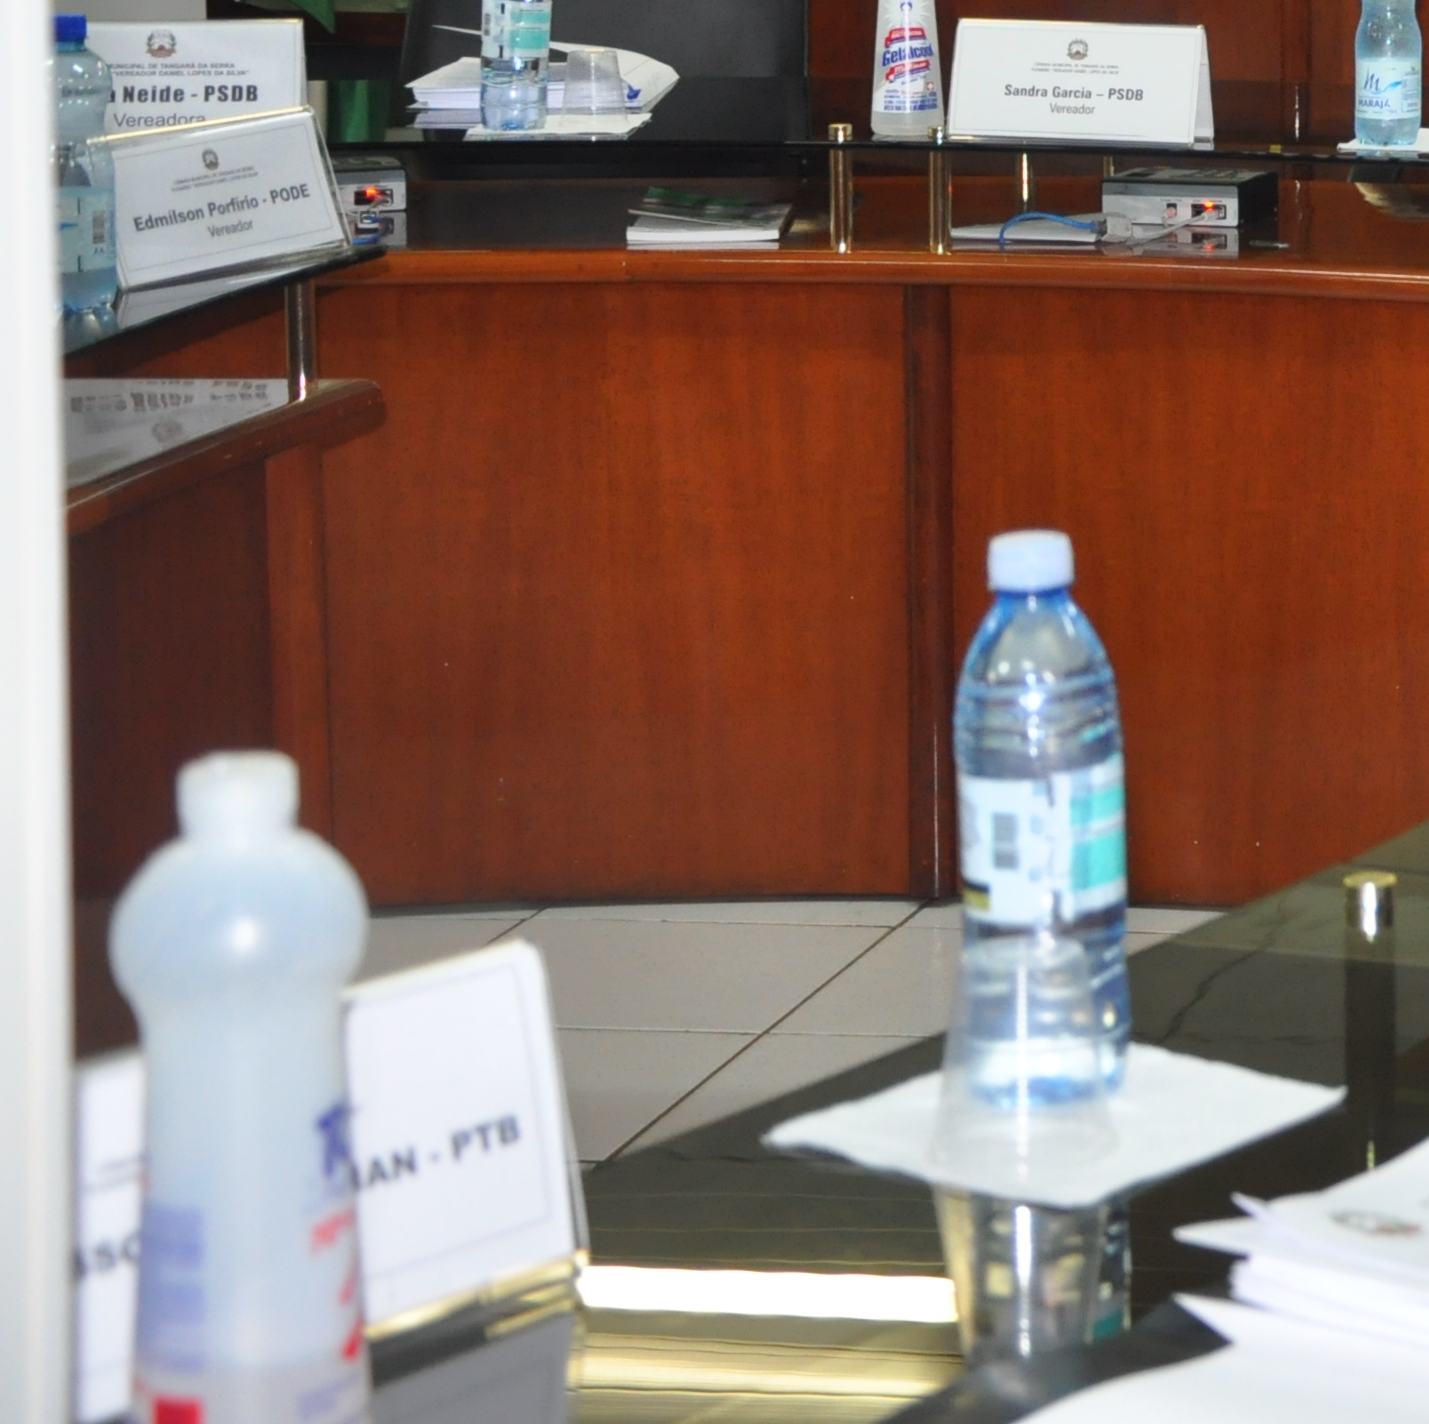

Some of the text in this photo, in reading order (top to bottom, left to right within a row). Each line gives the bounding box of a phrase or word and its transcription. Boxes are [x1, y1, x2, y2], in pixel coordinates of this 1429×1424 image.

[108, 62, 145, 70] UNICIPAL
[122, 85, 186, 103] Neide
[203, 84, 259, 102] PSDB
[1004, 84, 1144, 102] Sandra Garcia PSDB
[1049, 102, 1096, 115] Vereador
[113, 112, 206, 128] Vereadora
[133, 206, 205, 232] Edmilson
[269, 183, 311, 205] PODE
[207, 219, 254, 238] Vereador
[450, 1113, 521, 1166] PTB
